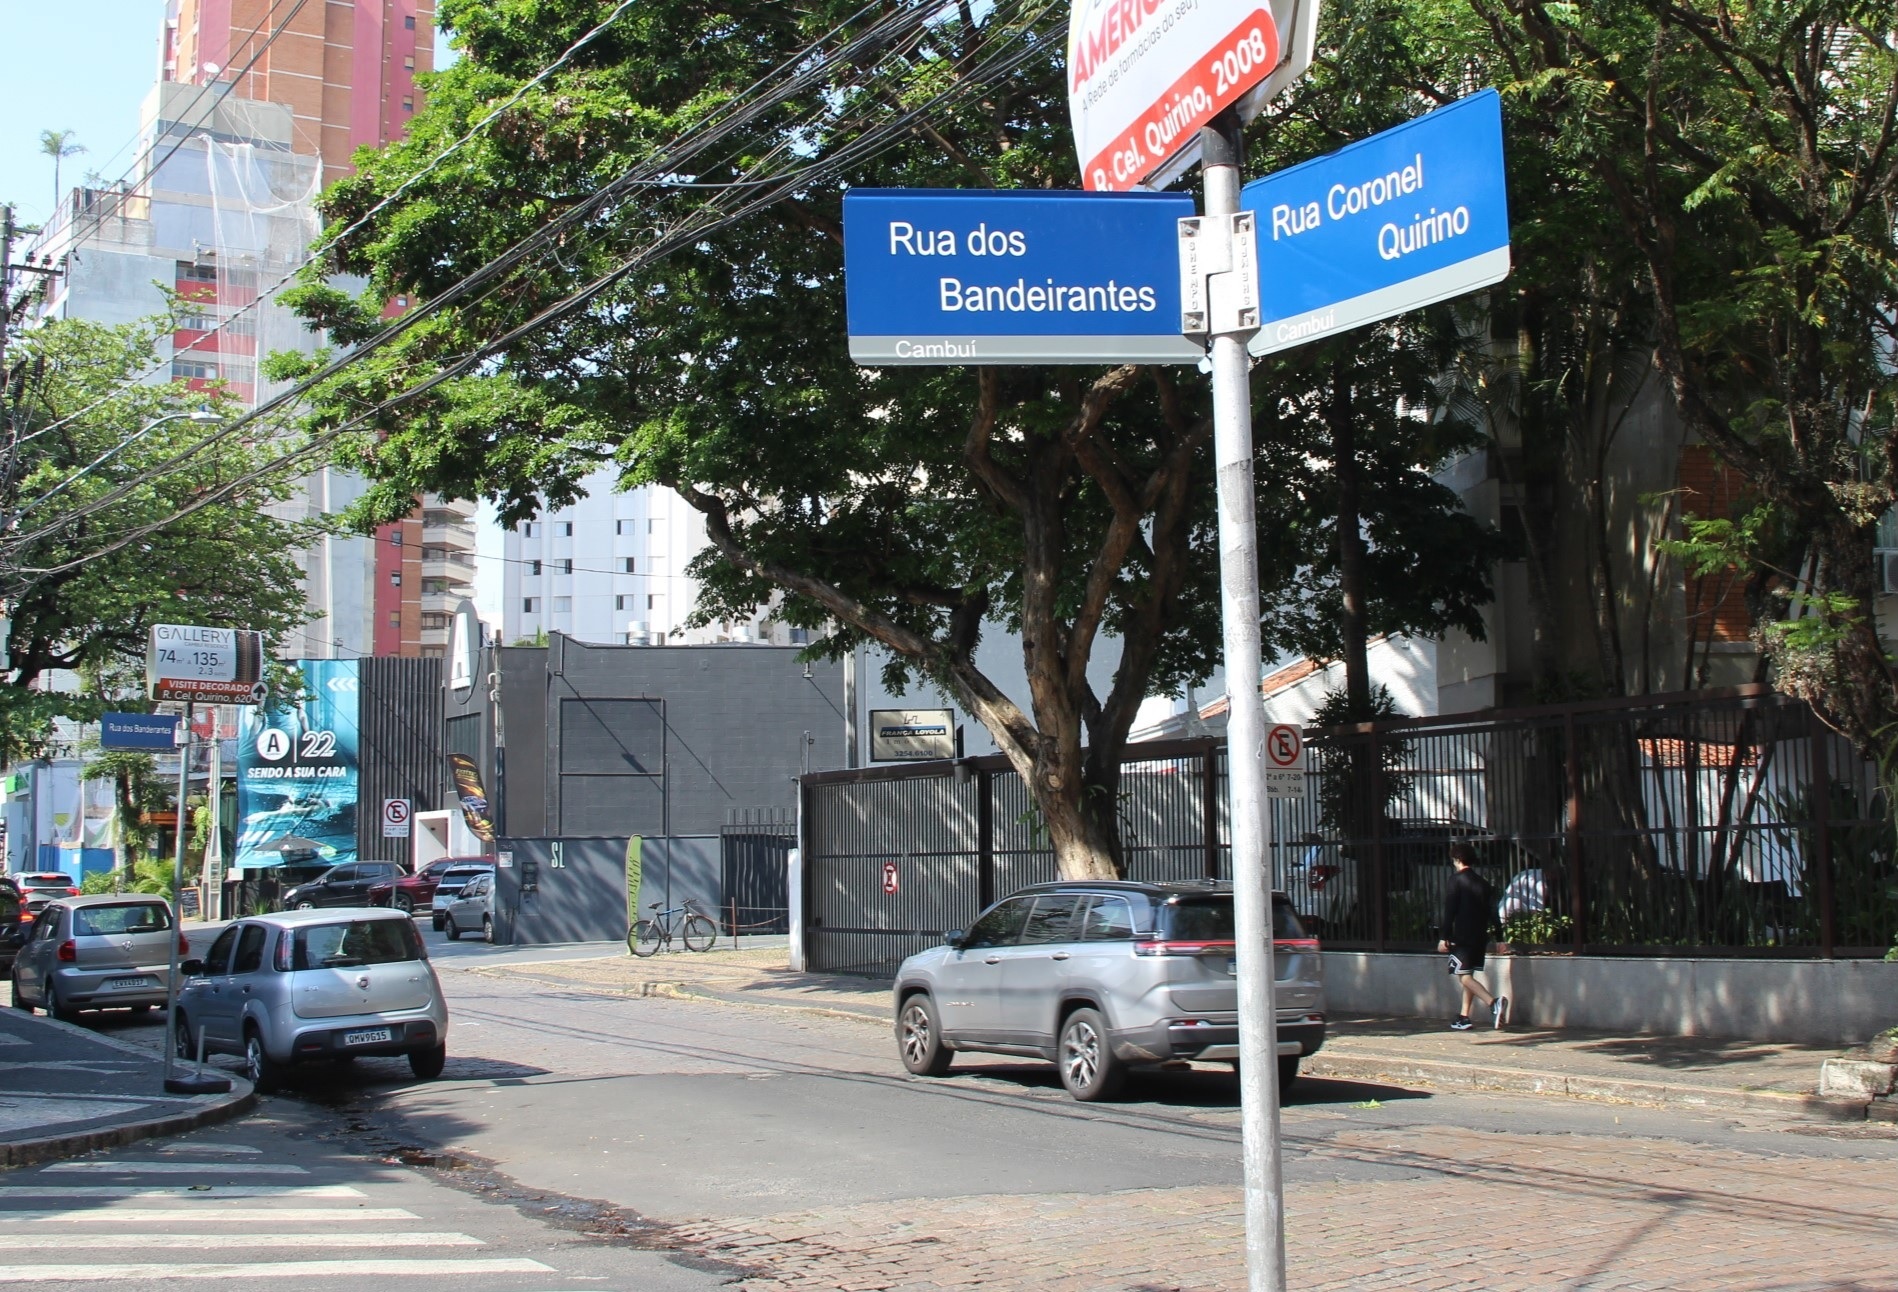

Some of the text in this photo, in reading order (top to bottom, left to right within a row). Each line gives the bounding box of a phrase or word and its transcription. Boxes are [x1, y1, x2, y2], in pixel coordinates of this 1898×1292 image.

[1088, 80, 1108, 107] Rede
[1108, 69, 1119, 87] de
[1162, 13, 1174, 33] do
[1092, 28, 1266, 192] R. Cel. Quirino, 2008
[1272, 153, 1423, 240] Rua Coronel
[889, 221, 1027, 256] Rua dos
[1377, 206, 1470, 261] Quirino
[939, 278, 1156, 312] Bandeirantes
[1276, 310, 1335, 343] Cambuí
[895, 340, 977, 358] Cambuí
[157, 627, 231, 643] GALLERY
[163, 690, 171, 699] R.
[195, 692, 231, 703] Quirino,
[234, 694, 253, 704] 620
[169, 680, 250, 692] VISITE DECORADO
[109, 723, 121, 732] Rua
[123, 724, 133, 732] dos
[267, 731, 337, 758] A 22
[247, 766, 346, 778] SENDO A SUA CARA
